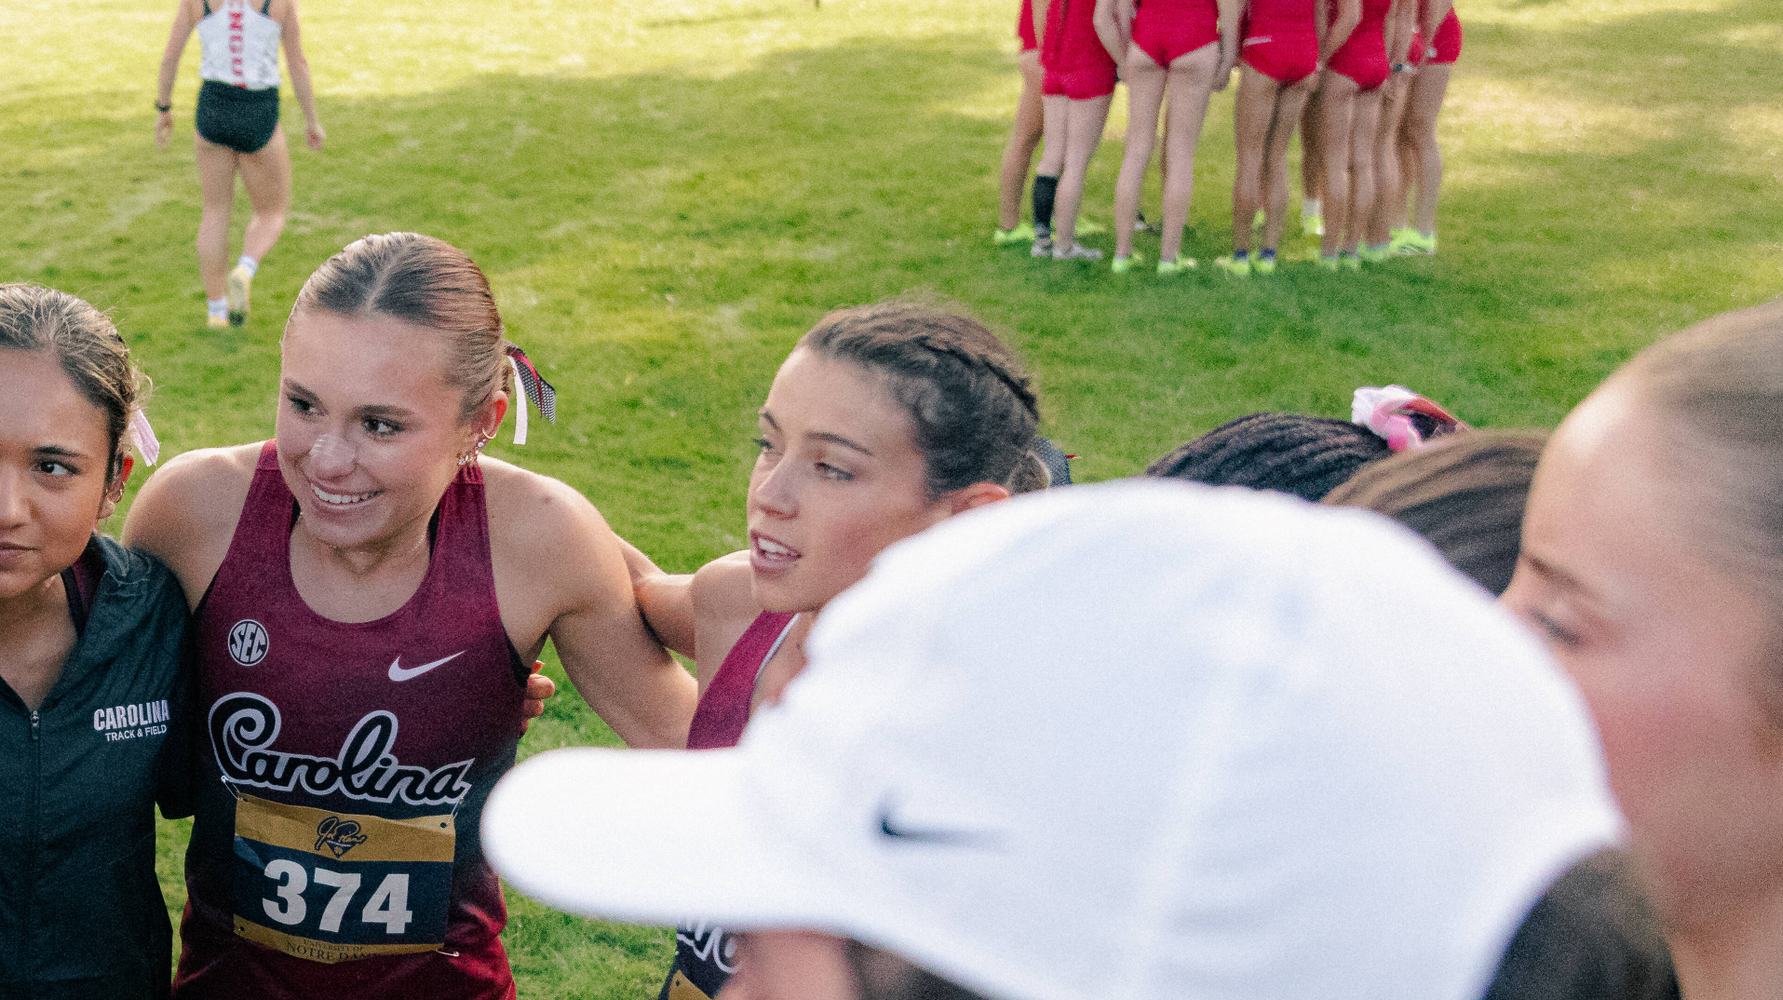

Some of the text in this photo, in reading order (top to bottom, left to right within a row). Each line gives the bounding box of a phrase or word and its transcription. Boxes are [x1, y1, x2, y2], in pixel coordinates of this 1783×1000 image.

[230, 621, 266, 665] SEC
[93, 699, 170, 731] CAROLINA
[105, 724, 167, 742] TRACK & FIELD
[208, 692, 475, 806] Carolina
[262, 858, 413, 934] 374
[285, 941, 335, 961] NOTRE
